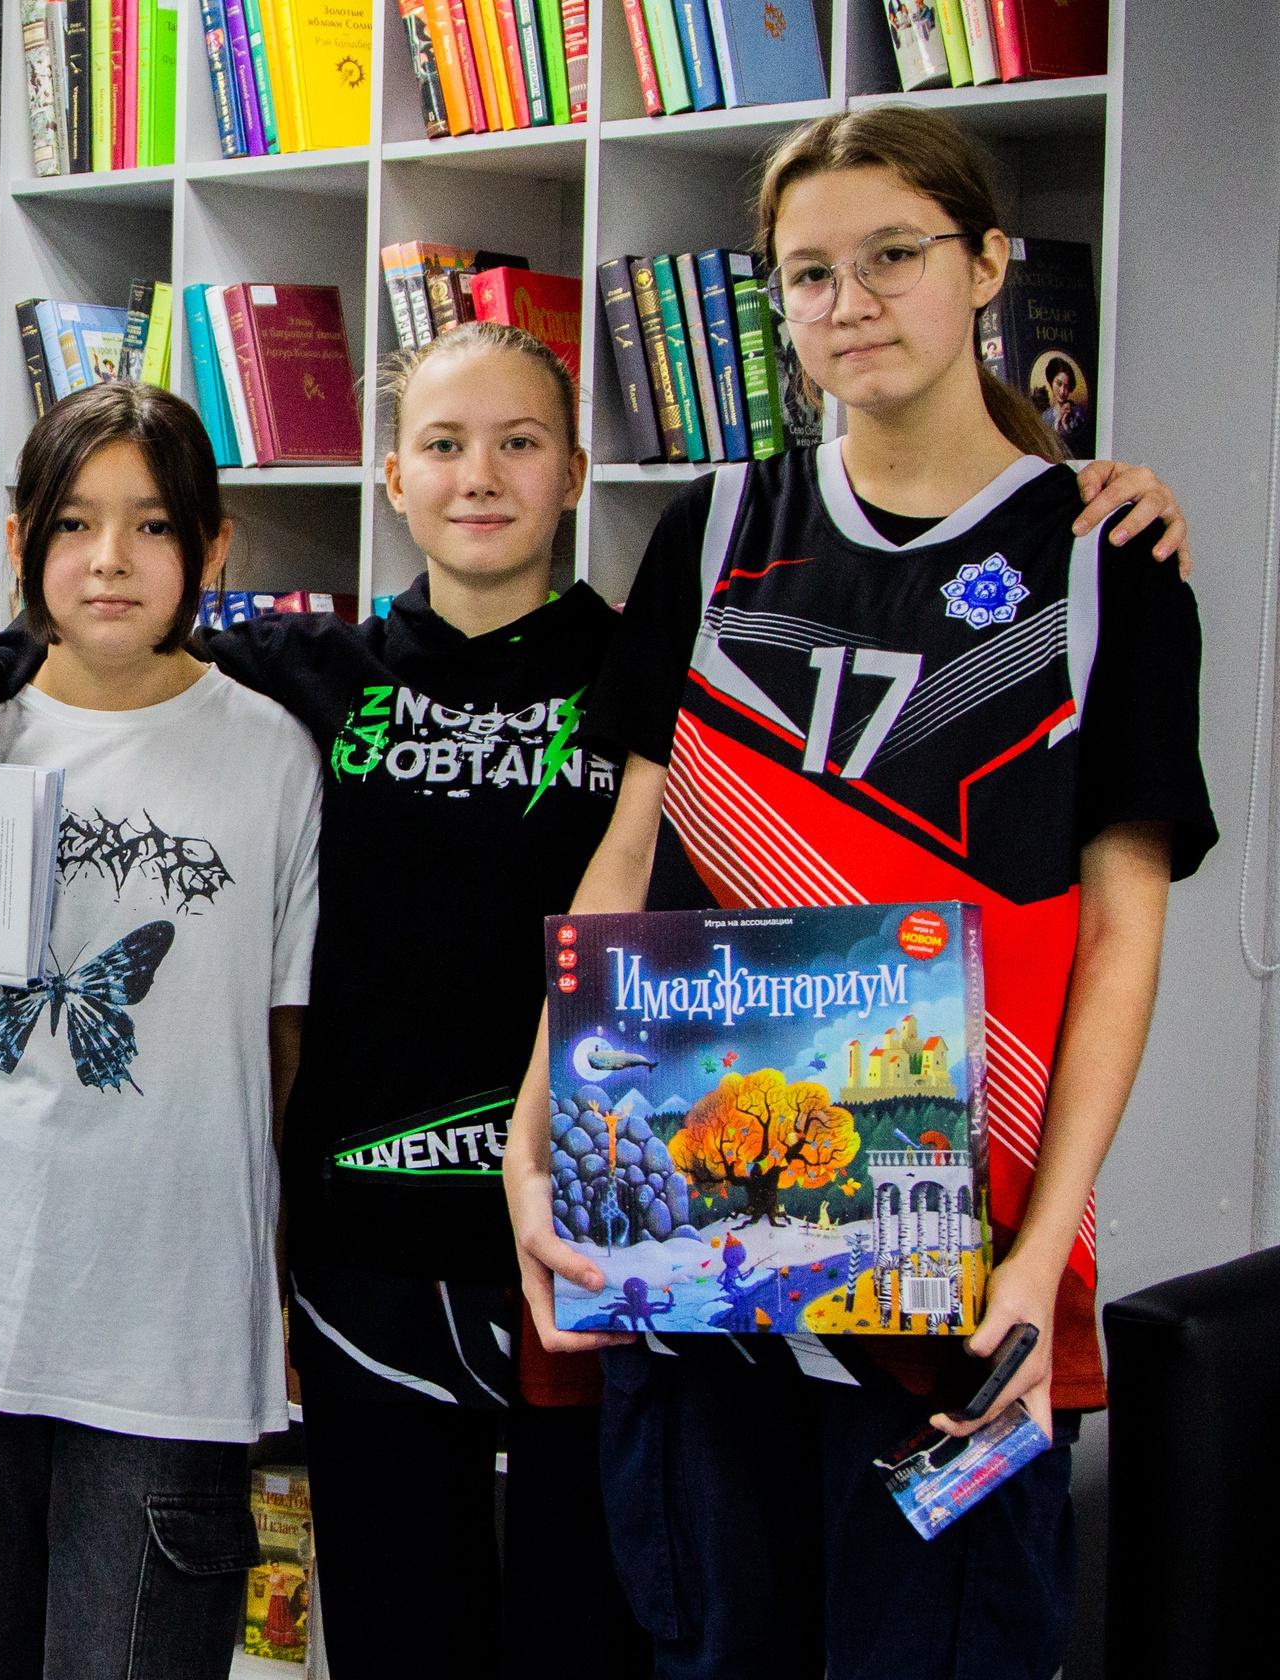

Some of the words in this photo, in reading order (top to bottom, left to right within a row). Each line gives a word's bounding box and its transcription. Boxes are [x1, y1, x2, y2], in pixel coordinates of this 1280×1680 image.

[308, 17, 342, 28] яблоки
[345, 20, 372, 30] Солн
[323, 6, 364, 18] Золотые
[315, 36, 332, 46] Рэй
[335, 37, 372, 50] Брэдбер
[528, 59, 540, 96] МАРГАРИТА
[392, 289, 415, 348] БЕСЫ
[410, 289, 433, 347] БЕСЫ
[1028, 299, 1077, 319] Белые
[1036, 327, 1073, 342] ночи
[653, 340, 674, 403] ДОСТОЕВСКИЙ
[628, 383, 638, 412] Идиот
[719, 382, 729, 424] наказание
[724, 365, 736, 425] Преступление
[682, 398, 694, 433] Повести
[802, 646, 924, 779] 17
[386, 740, 583, 788] OBTAIN
[561, 930, 573, 939] 30
[704, 919, 726, 929] Игра
[728, 919, 739, 927] на
[740, 917, 794, 928] ассоциации
[902, 932, 942, 946] НОВОМ
[558, 954, 575, 963] 4-7
[559, 978, 576, 987] 12+
[606, 943, 909, 1026] Имаджинариум
[257, 1513, 269, 1531] 11
